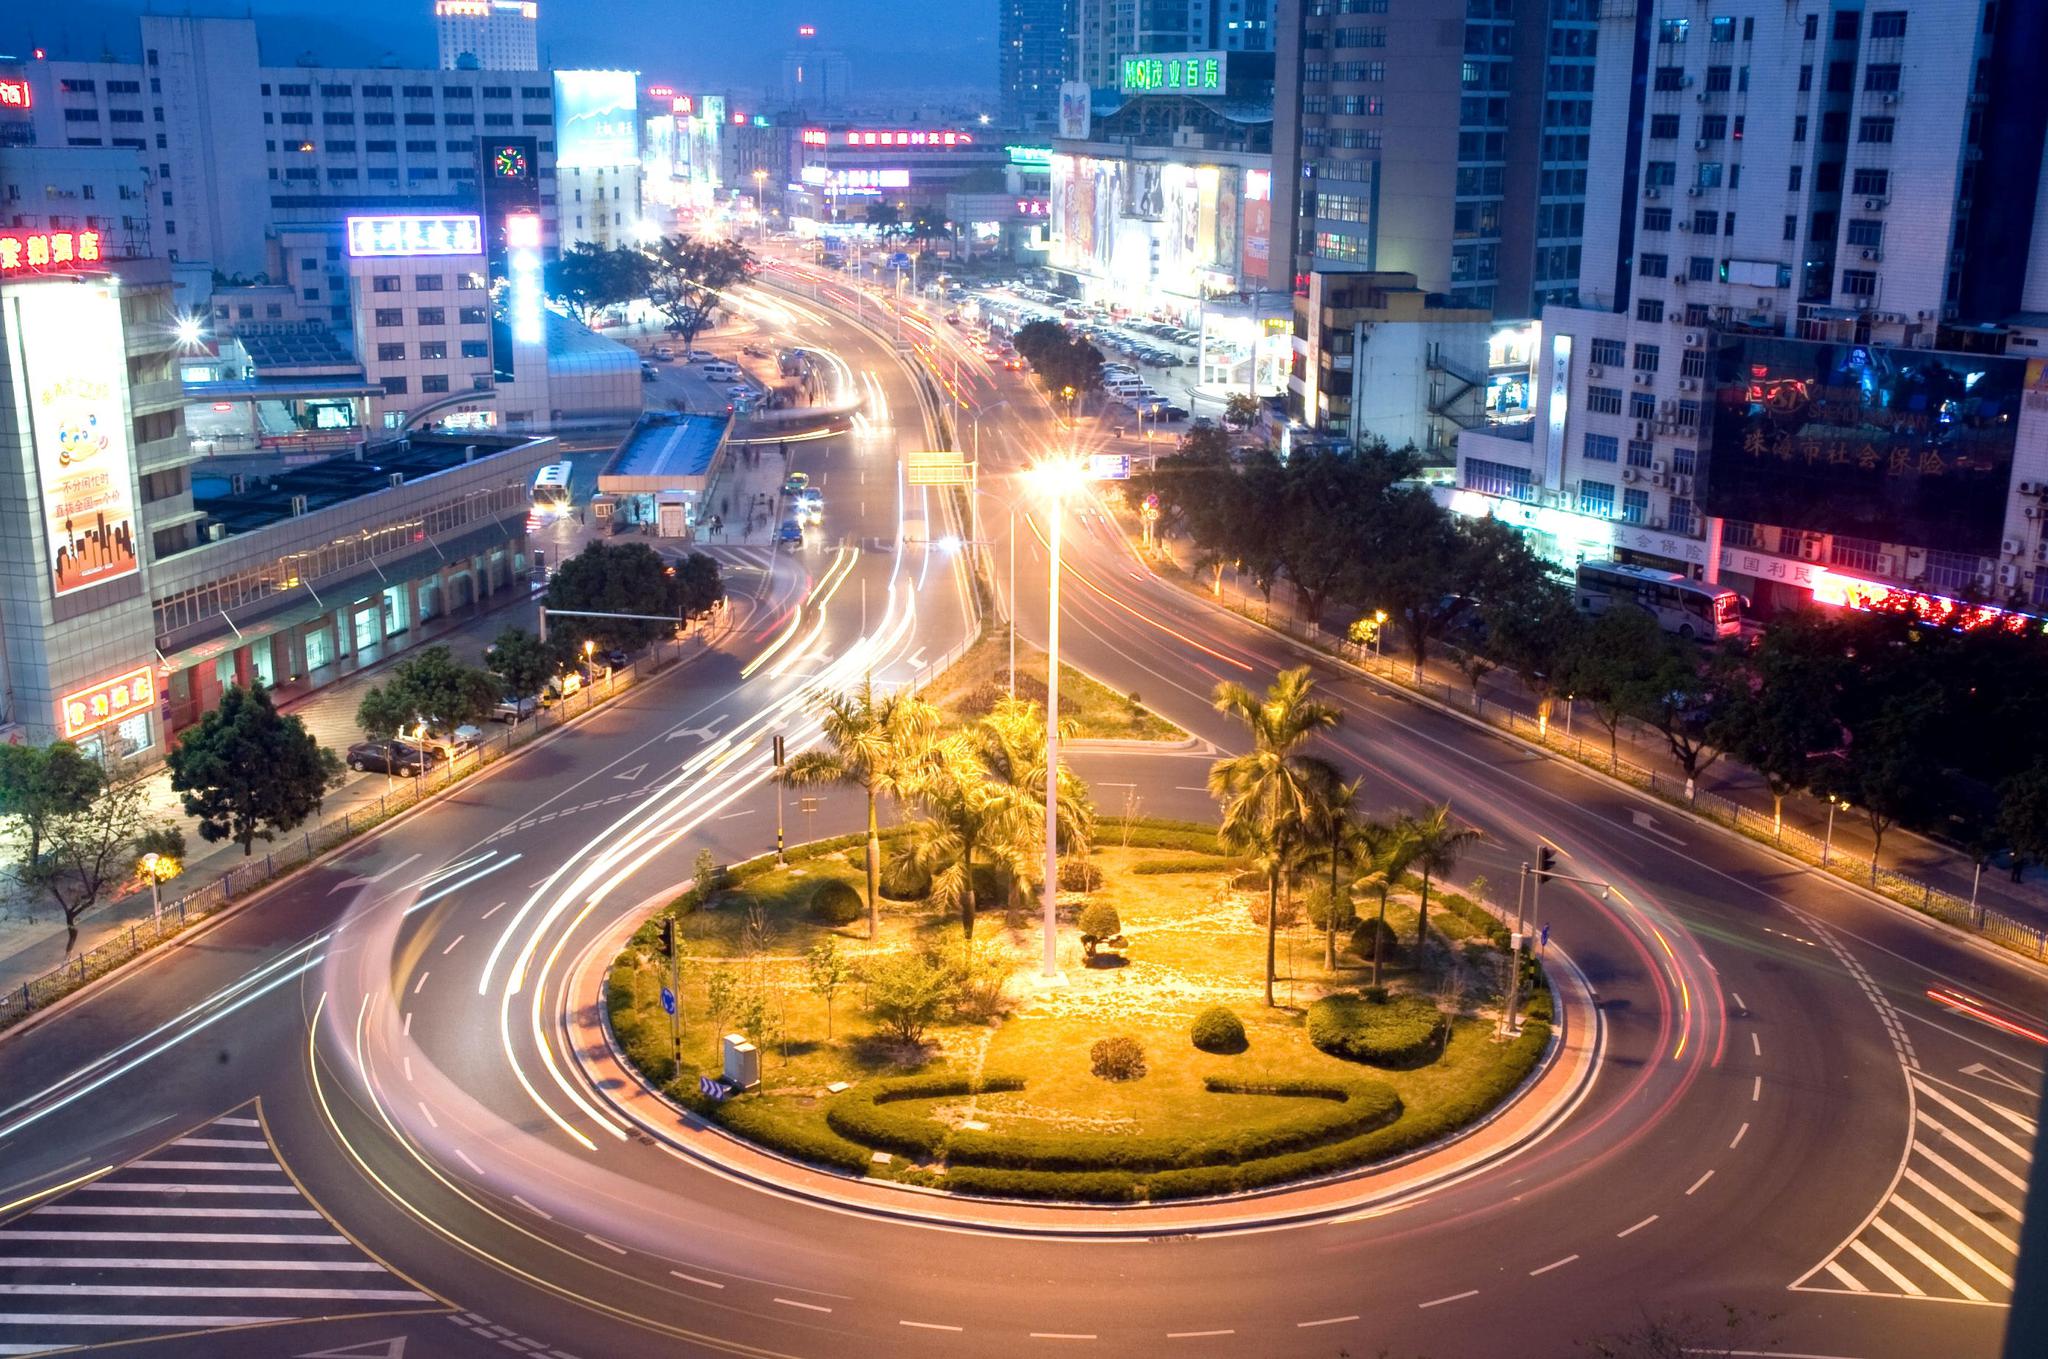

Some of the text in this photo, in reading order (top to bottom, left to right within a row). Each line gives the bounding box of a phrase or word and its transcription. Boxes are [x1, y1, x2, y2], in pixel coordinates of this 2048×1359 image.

[1151, 58, 1218, 88] 茂业百货
[1612, 530, 1704, 561] 社会保险
